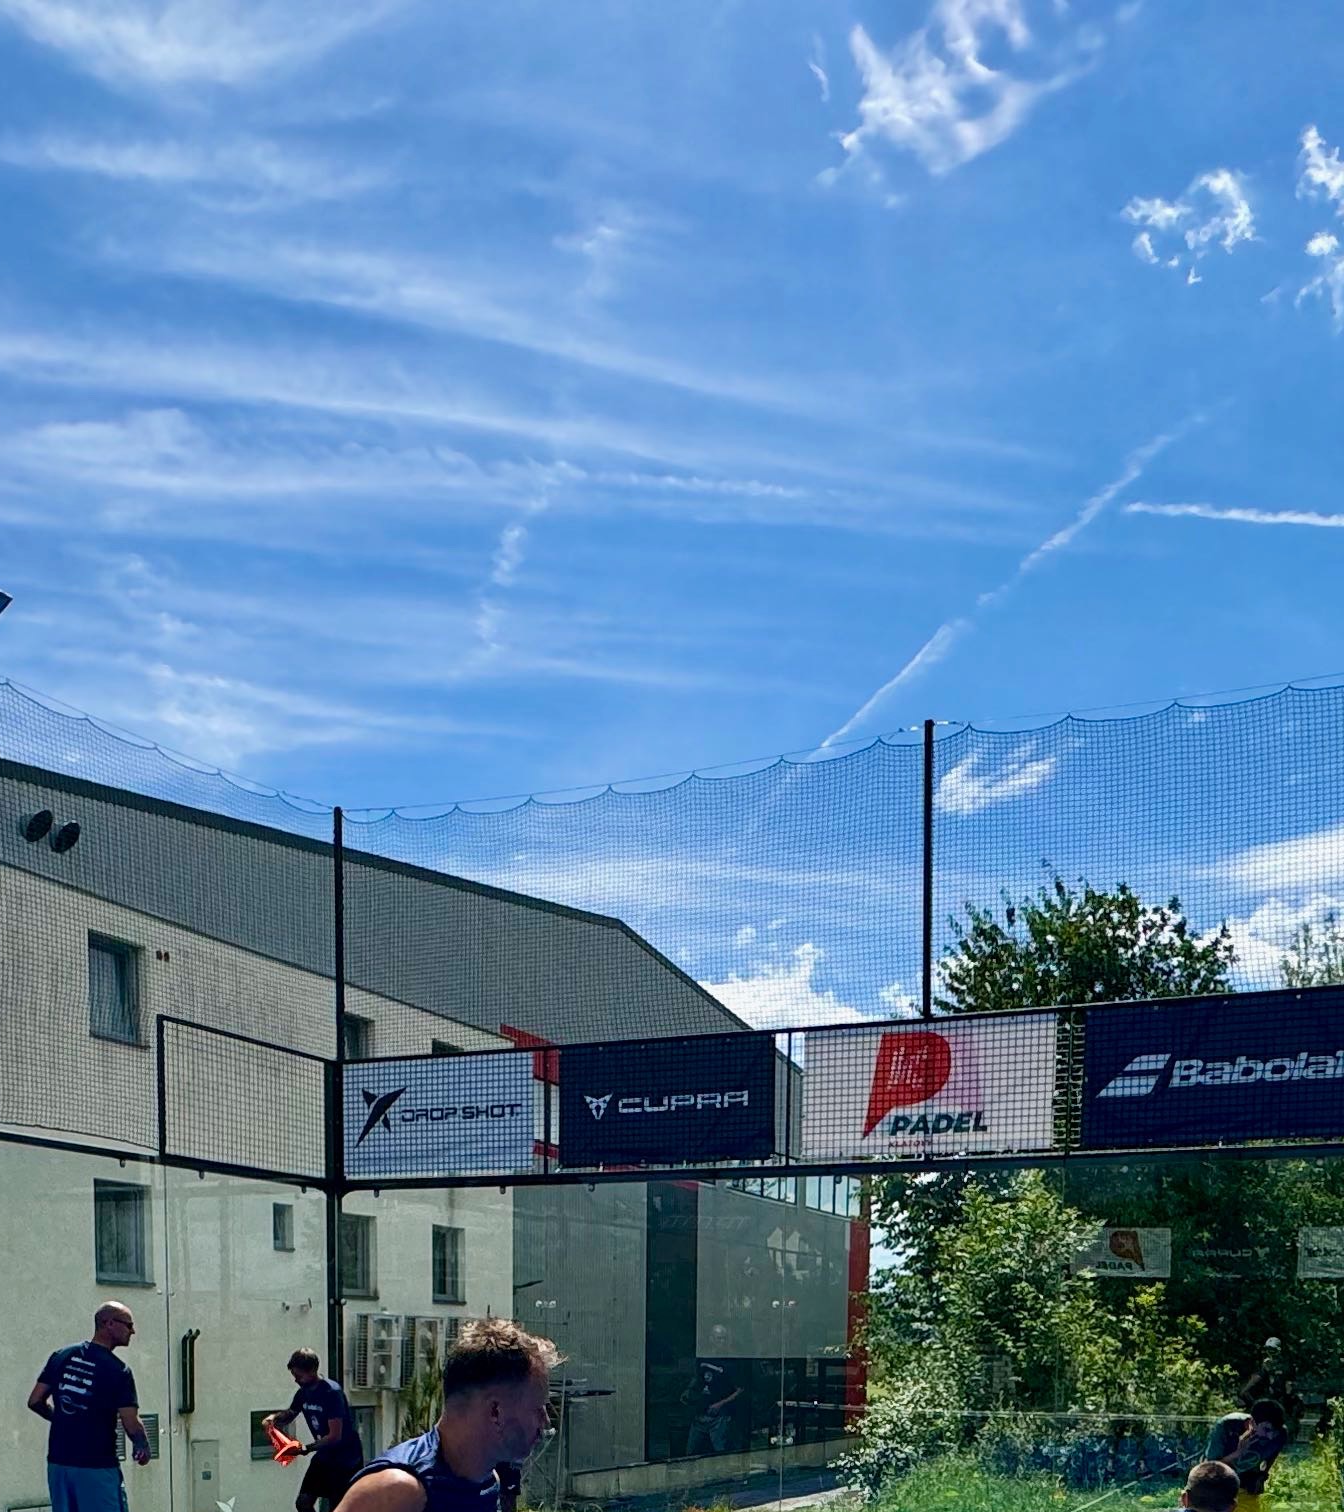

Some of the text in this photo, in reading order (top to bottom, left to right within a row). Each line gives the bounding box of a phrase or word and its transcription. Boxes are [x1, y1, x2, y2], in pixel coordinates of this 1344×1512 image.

[617, 1090, 750, 1114] CUPRA
[400, 1107, 458, 1122] DROP
[888, 1110, 988, 1136] PADEL
